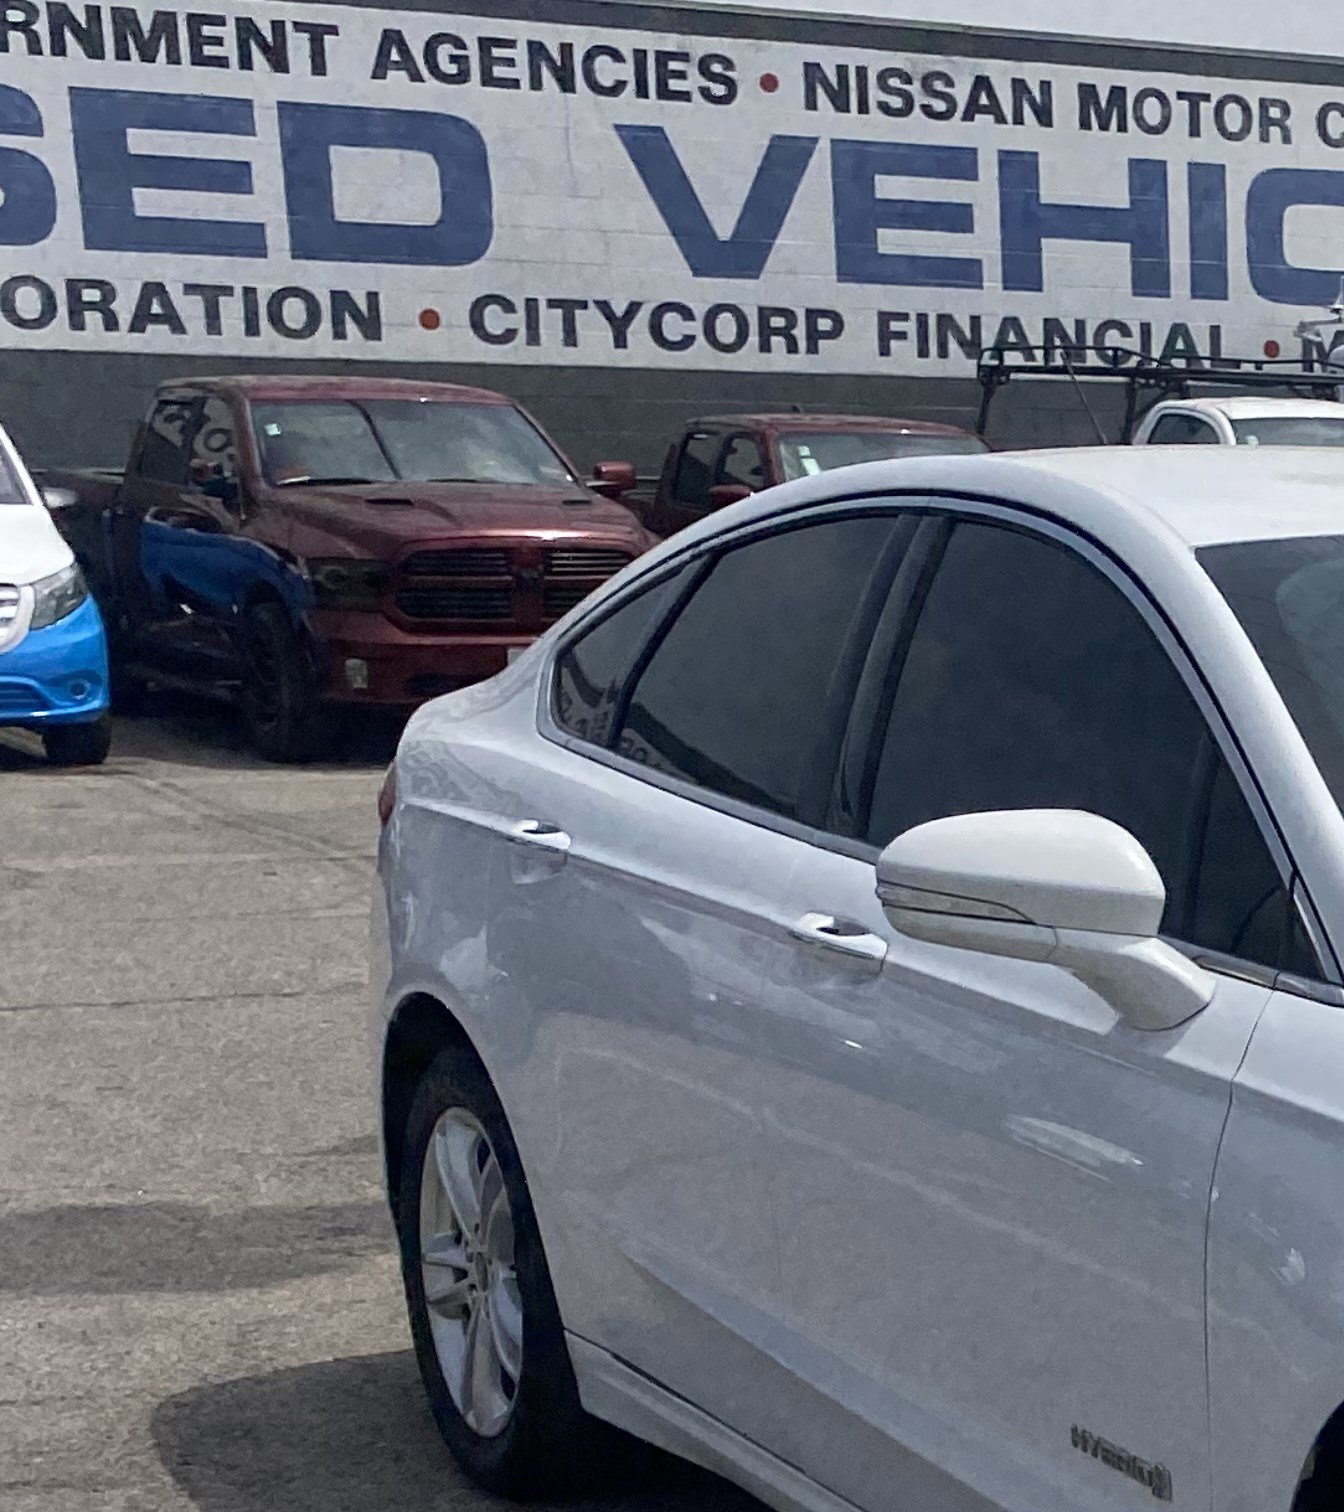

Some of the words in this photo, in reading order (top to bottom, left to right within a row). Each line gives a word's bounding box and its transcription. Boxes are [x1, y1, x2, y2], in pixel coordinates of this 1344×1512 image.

[370, 28, 739, 106] AGENCIES
[802, 61, 1054, 130] NISSAN
[1077, 82, 1293, 145] MOTOR
[0, 274, 384, 343] ORATION
[468, 292, 844, 356] CITYCORP
[877, 310, 1233, 371] FINANCIAL
